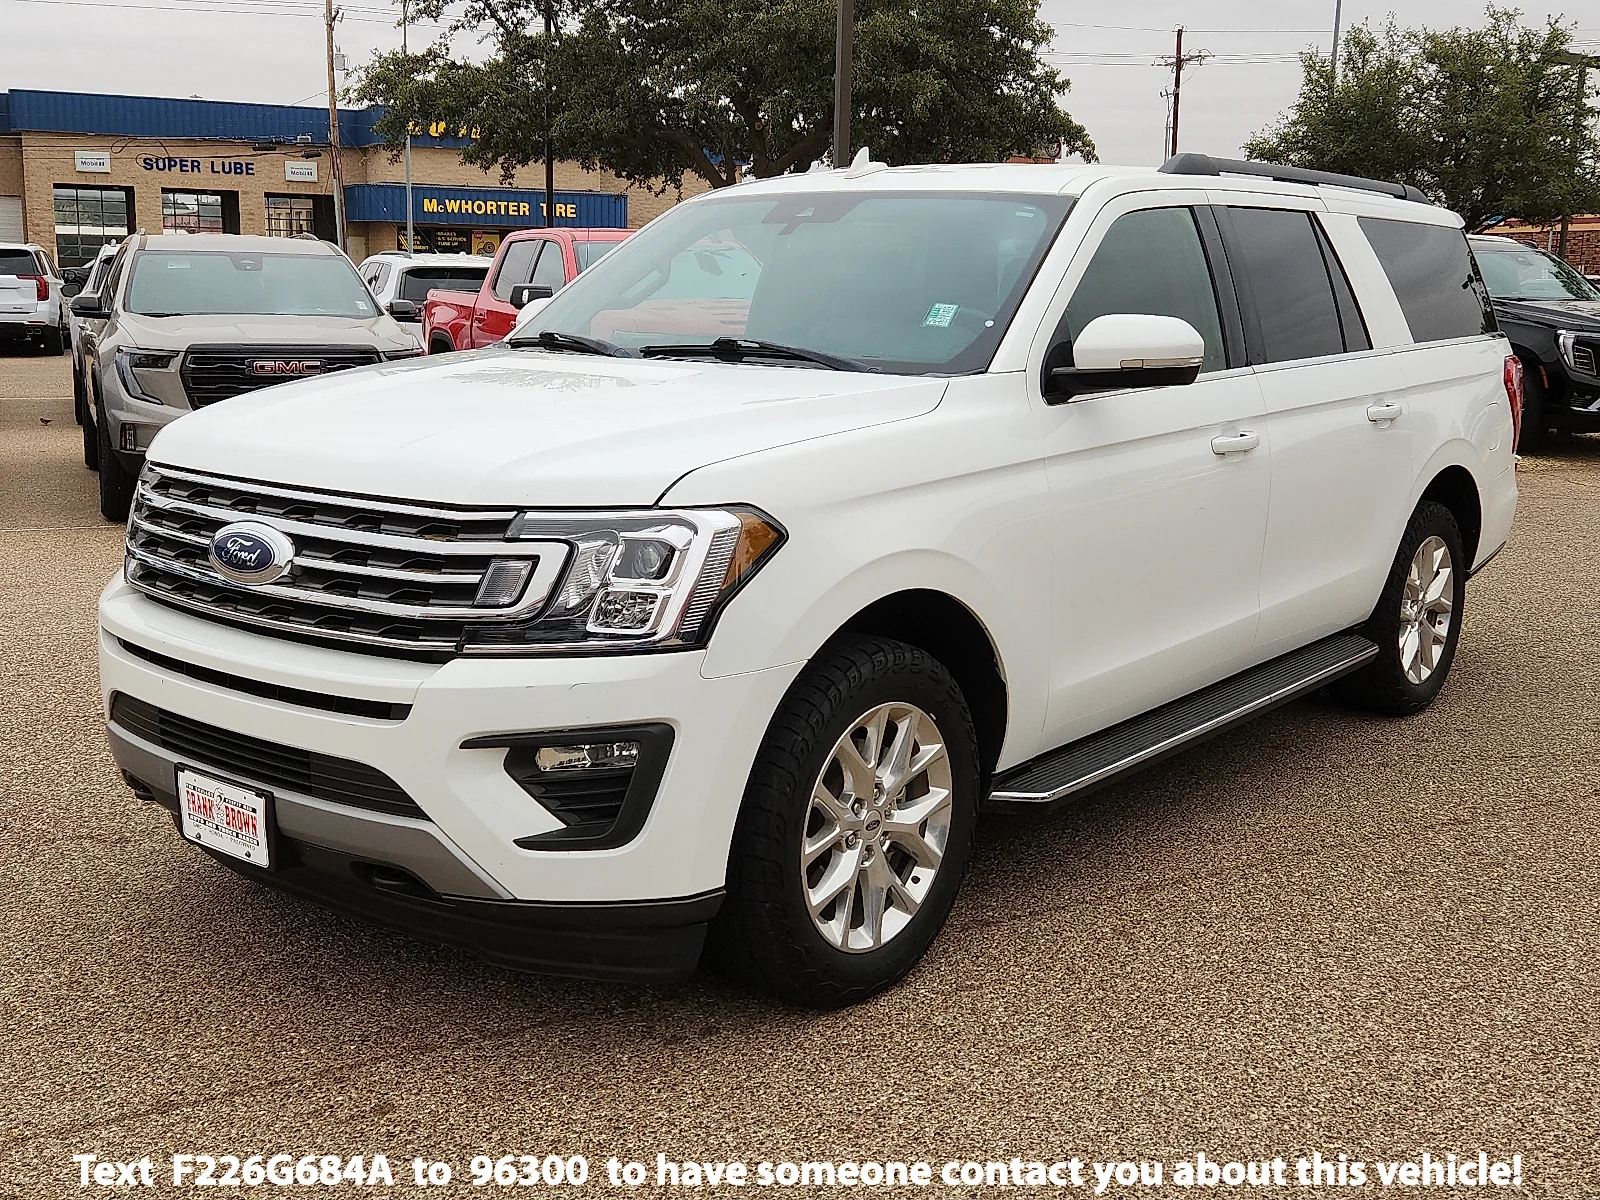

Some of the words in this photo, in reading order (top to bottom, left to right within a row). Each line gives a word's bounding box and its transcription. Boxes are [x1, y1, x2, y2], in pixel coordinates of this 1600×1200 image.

[142, 157, 201, 173] SUPER
[210, 160, 255, 176] LUBE
[423, 198, 530, 216] McWHORTER
[540, 202, 577, 218] TRE
[253, 360, 322, 375] GMC
[221, 535, 262, 567] Ford
[186, 789, 216, 821] FRANK
[224, 804, 259, 839] BROWN
